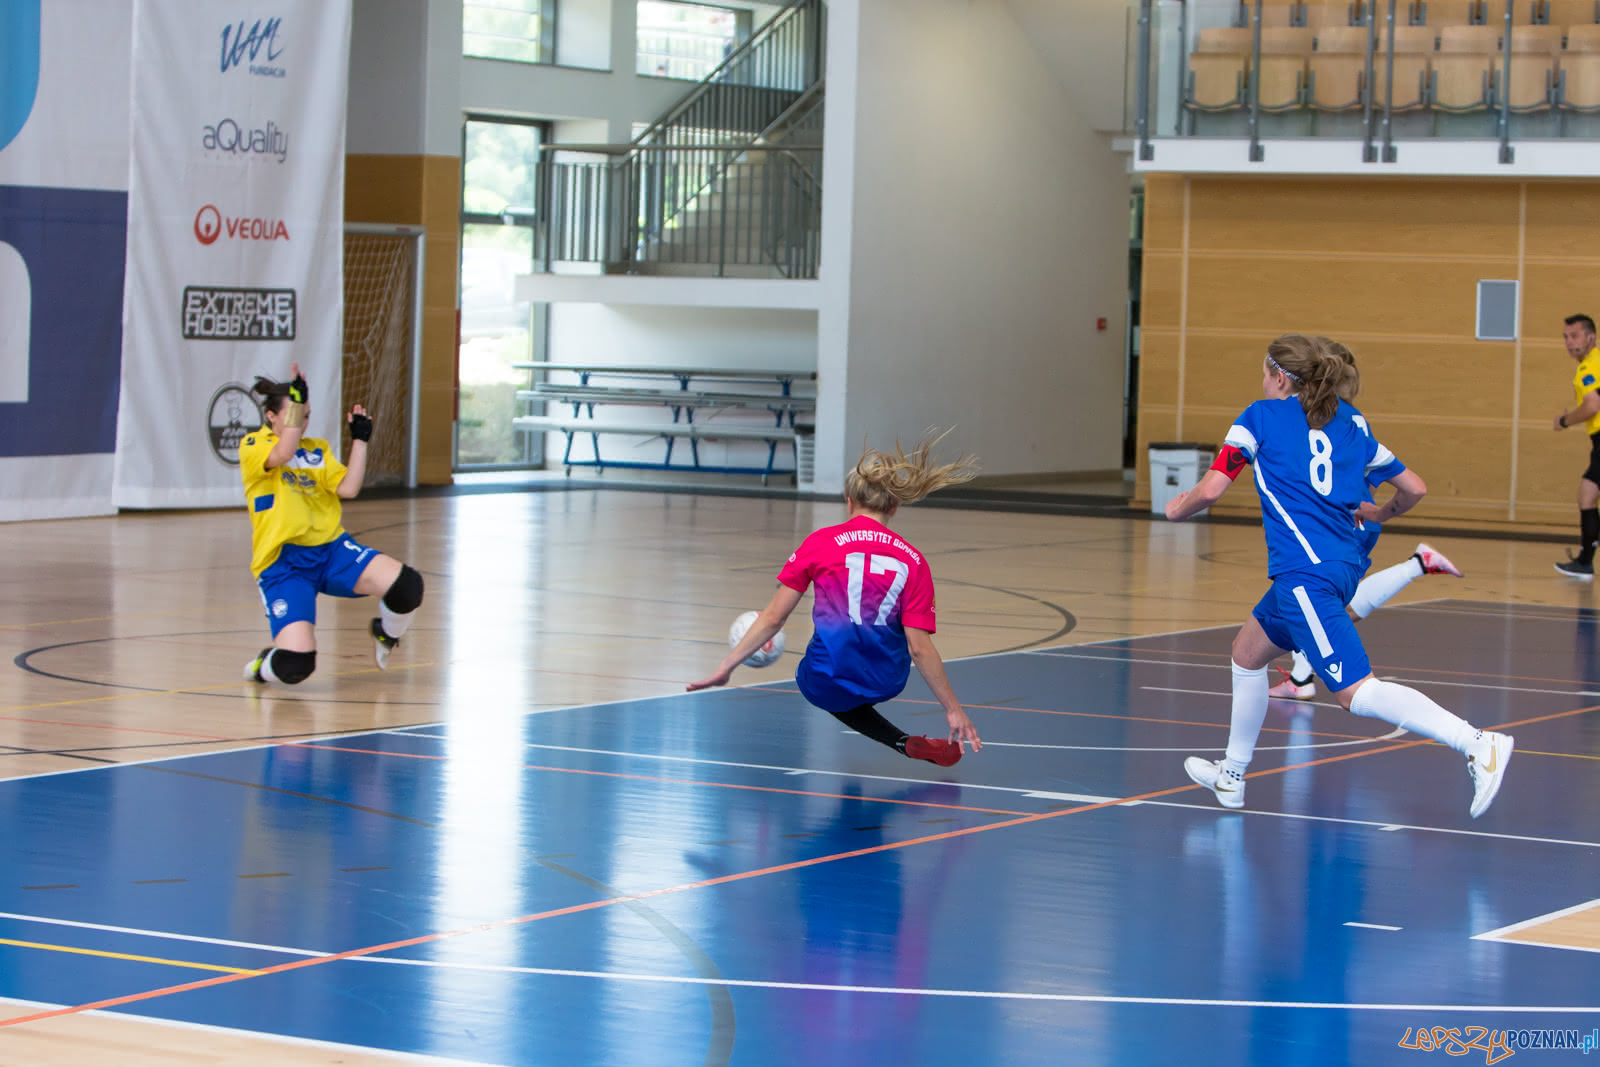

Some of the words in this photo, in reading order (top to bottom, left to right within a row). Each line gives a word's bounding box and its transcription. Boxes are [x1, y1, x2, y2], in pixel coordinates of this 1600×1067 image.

[203, 118, 289, 163] aQuality
[226, 218, 290, 240] VEOLIA
[186, 291, 293, 314] EXTREME
[1308, 428, 1333, 496] 8
[834, 529, 893, 547] UNIWERSYTET
[845, 552, 909, 626] 17
